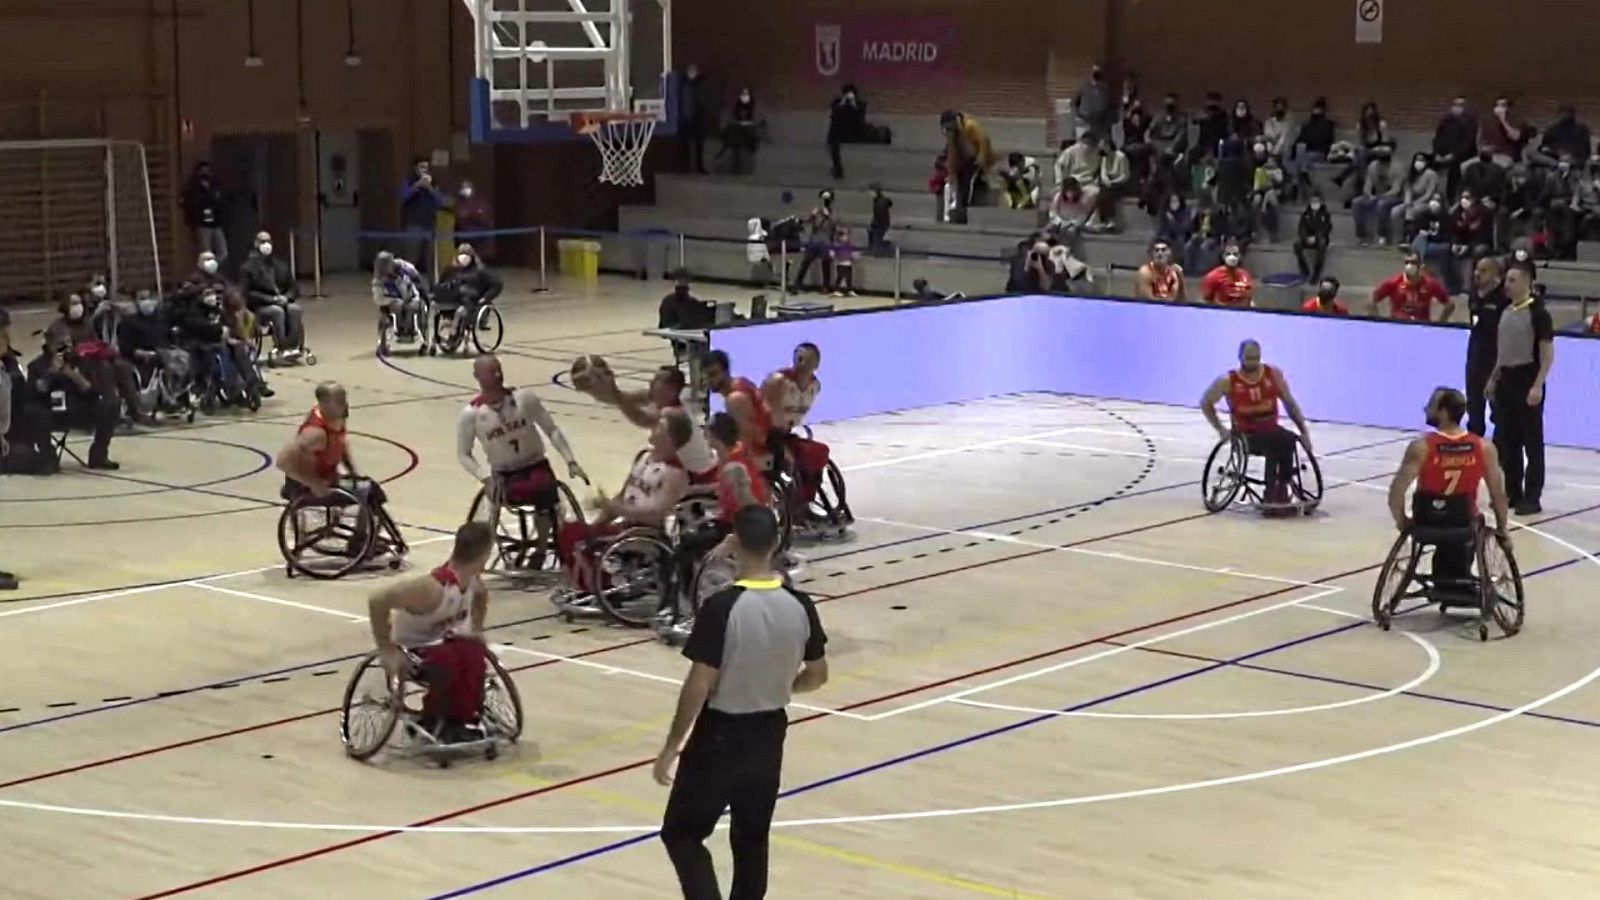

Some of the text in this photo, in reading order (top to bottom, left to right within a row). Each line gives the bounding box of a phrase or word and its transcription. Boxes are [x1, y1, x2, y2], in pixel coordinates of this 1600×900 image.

[862, 41, 938, 63] MADRID
[508, 439, 519, 453] 7
[1443, 469, 1462, 496] 7
